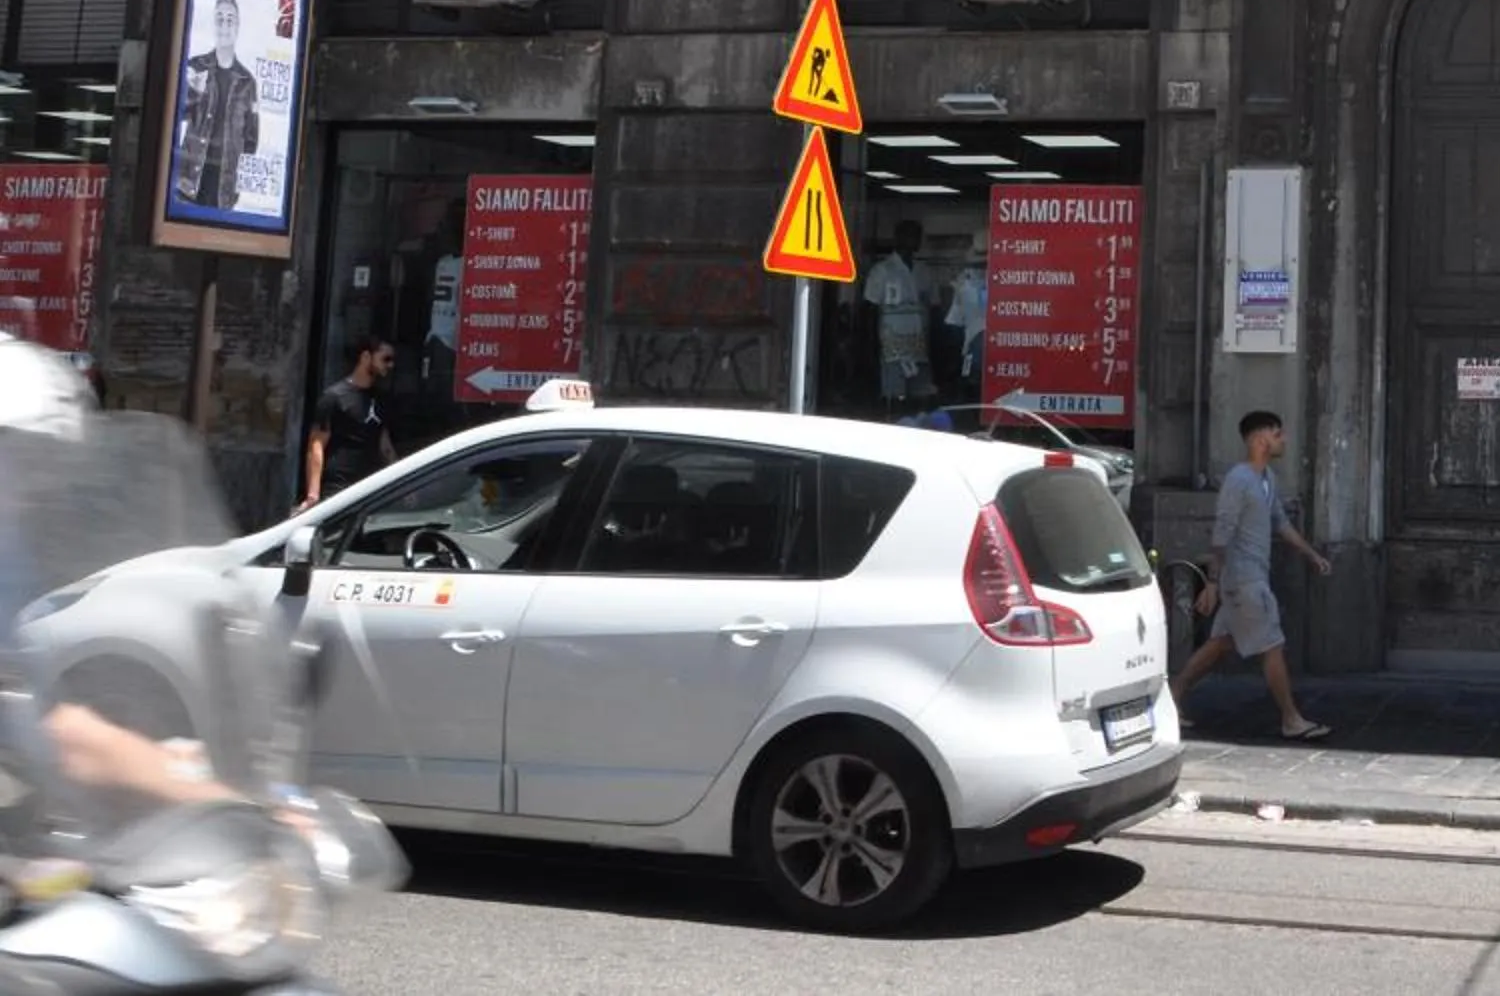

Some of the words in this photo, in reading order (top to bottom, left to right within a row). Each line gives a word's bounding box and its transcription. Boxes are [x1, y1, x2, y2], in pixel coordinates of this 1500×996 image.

[4, 176, 54, 200] SIAMO
[57, 176, 108, 199] FALLIT
[475, 187, 530, 212] SIAMO
[999, 198, 1061, 223] SIAMO
[1064, 198, 1134, 223] FALLITI
[1002, 239, 1047, 254] T-SHIRT
[1000, 269, 1035, 285] SHORT
[1036, 270, 1076, 285] DONNA
[997, 300, 1051, 317] COSTUME
[995, 362, 1032, 379] JEANS
[1039, 395, 1103, 412] ENTRATA
[373, 584, 415, 604] 4031
